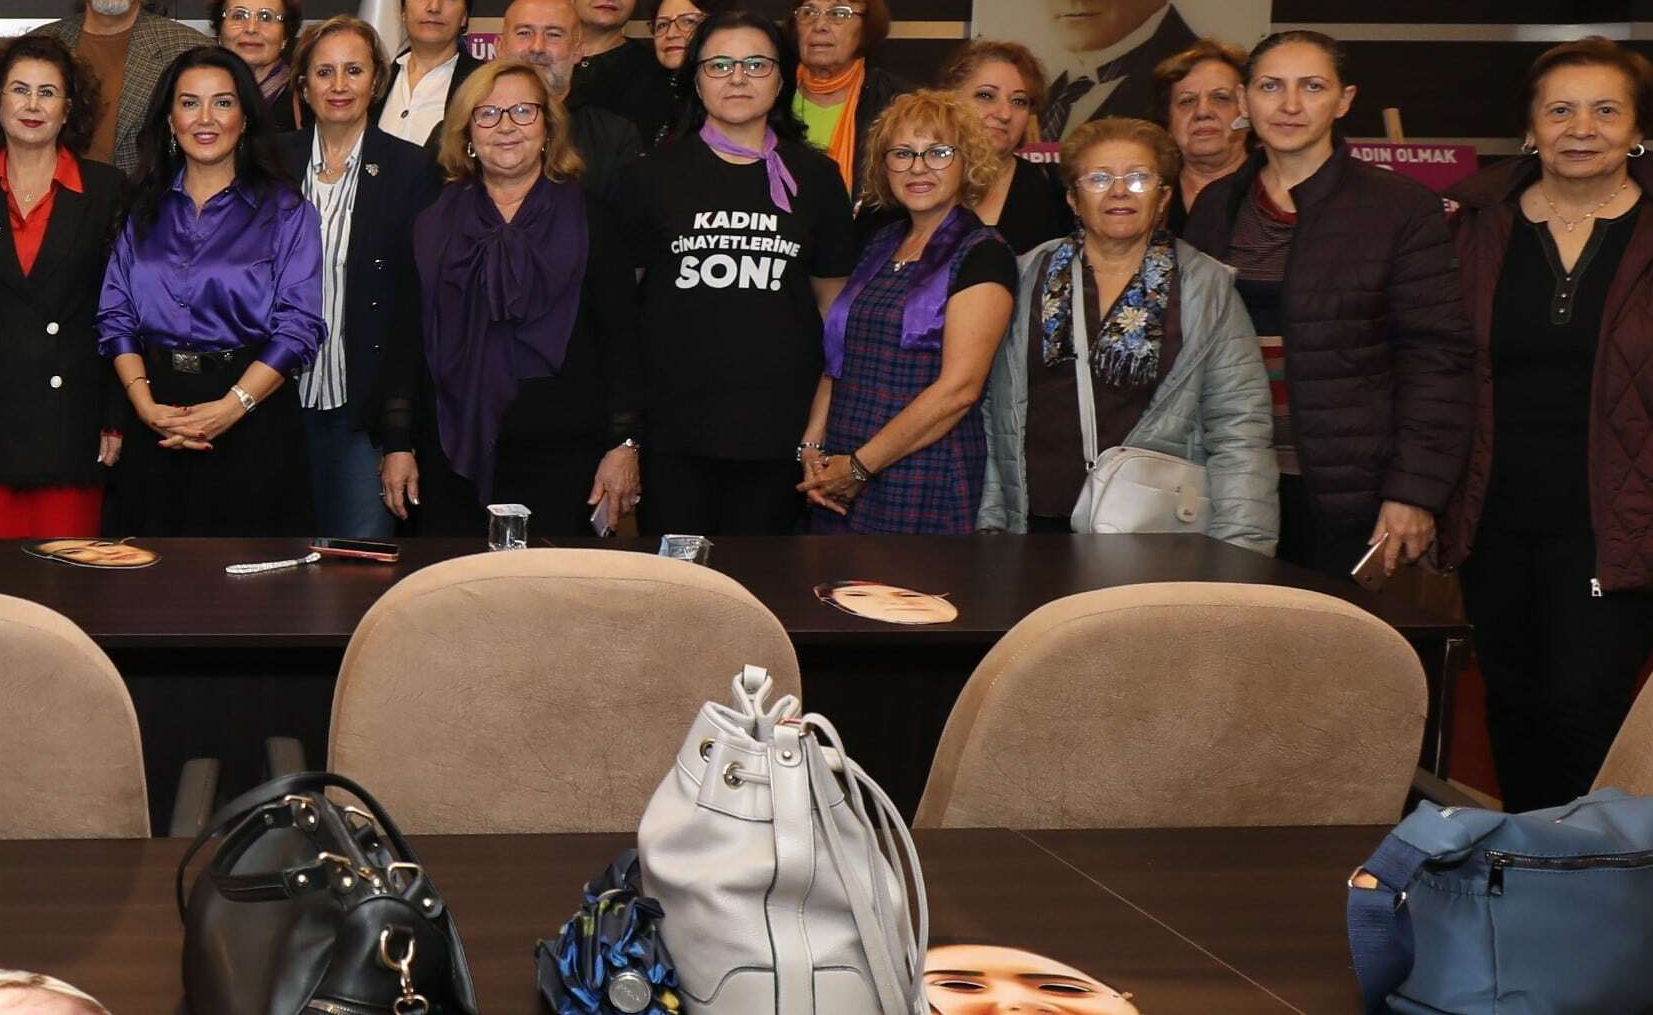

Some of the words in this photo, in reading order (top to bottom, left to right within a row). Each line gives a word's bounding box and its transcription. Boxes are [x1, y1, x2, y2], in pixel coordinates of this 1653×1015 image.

[1350, 147, 1393, 163] ADIN
[1395, 148, 1458, 164] OLMAK
[693, 210, 778, 232] KADIN
[670, 235, 802, 257] CİNAYETLERİNE
[675, 253, 788, 291] SON!
